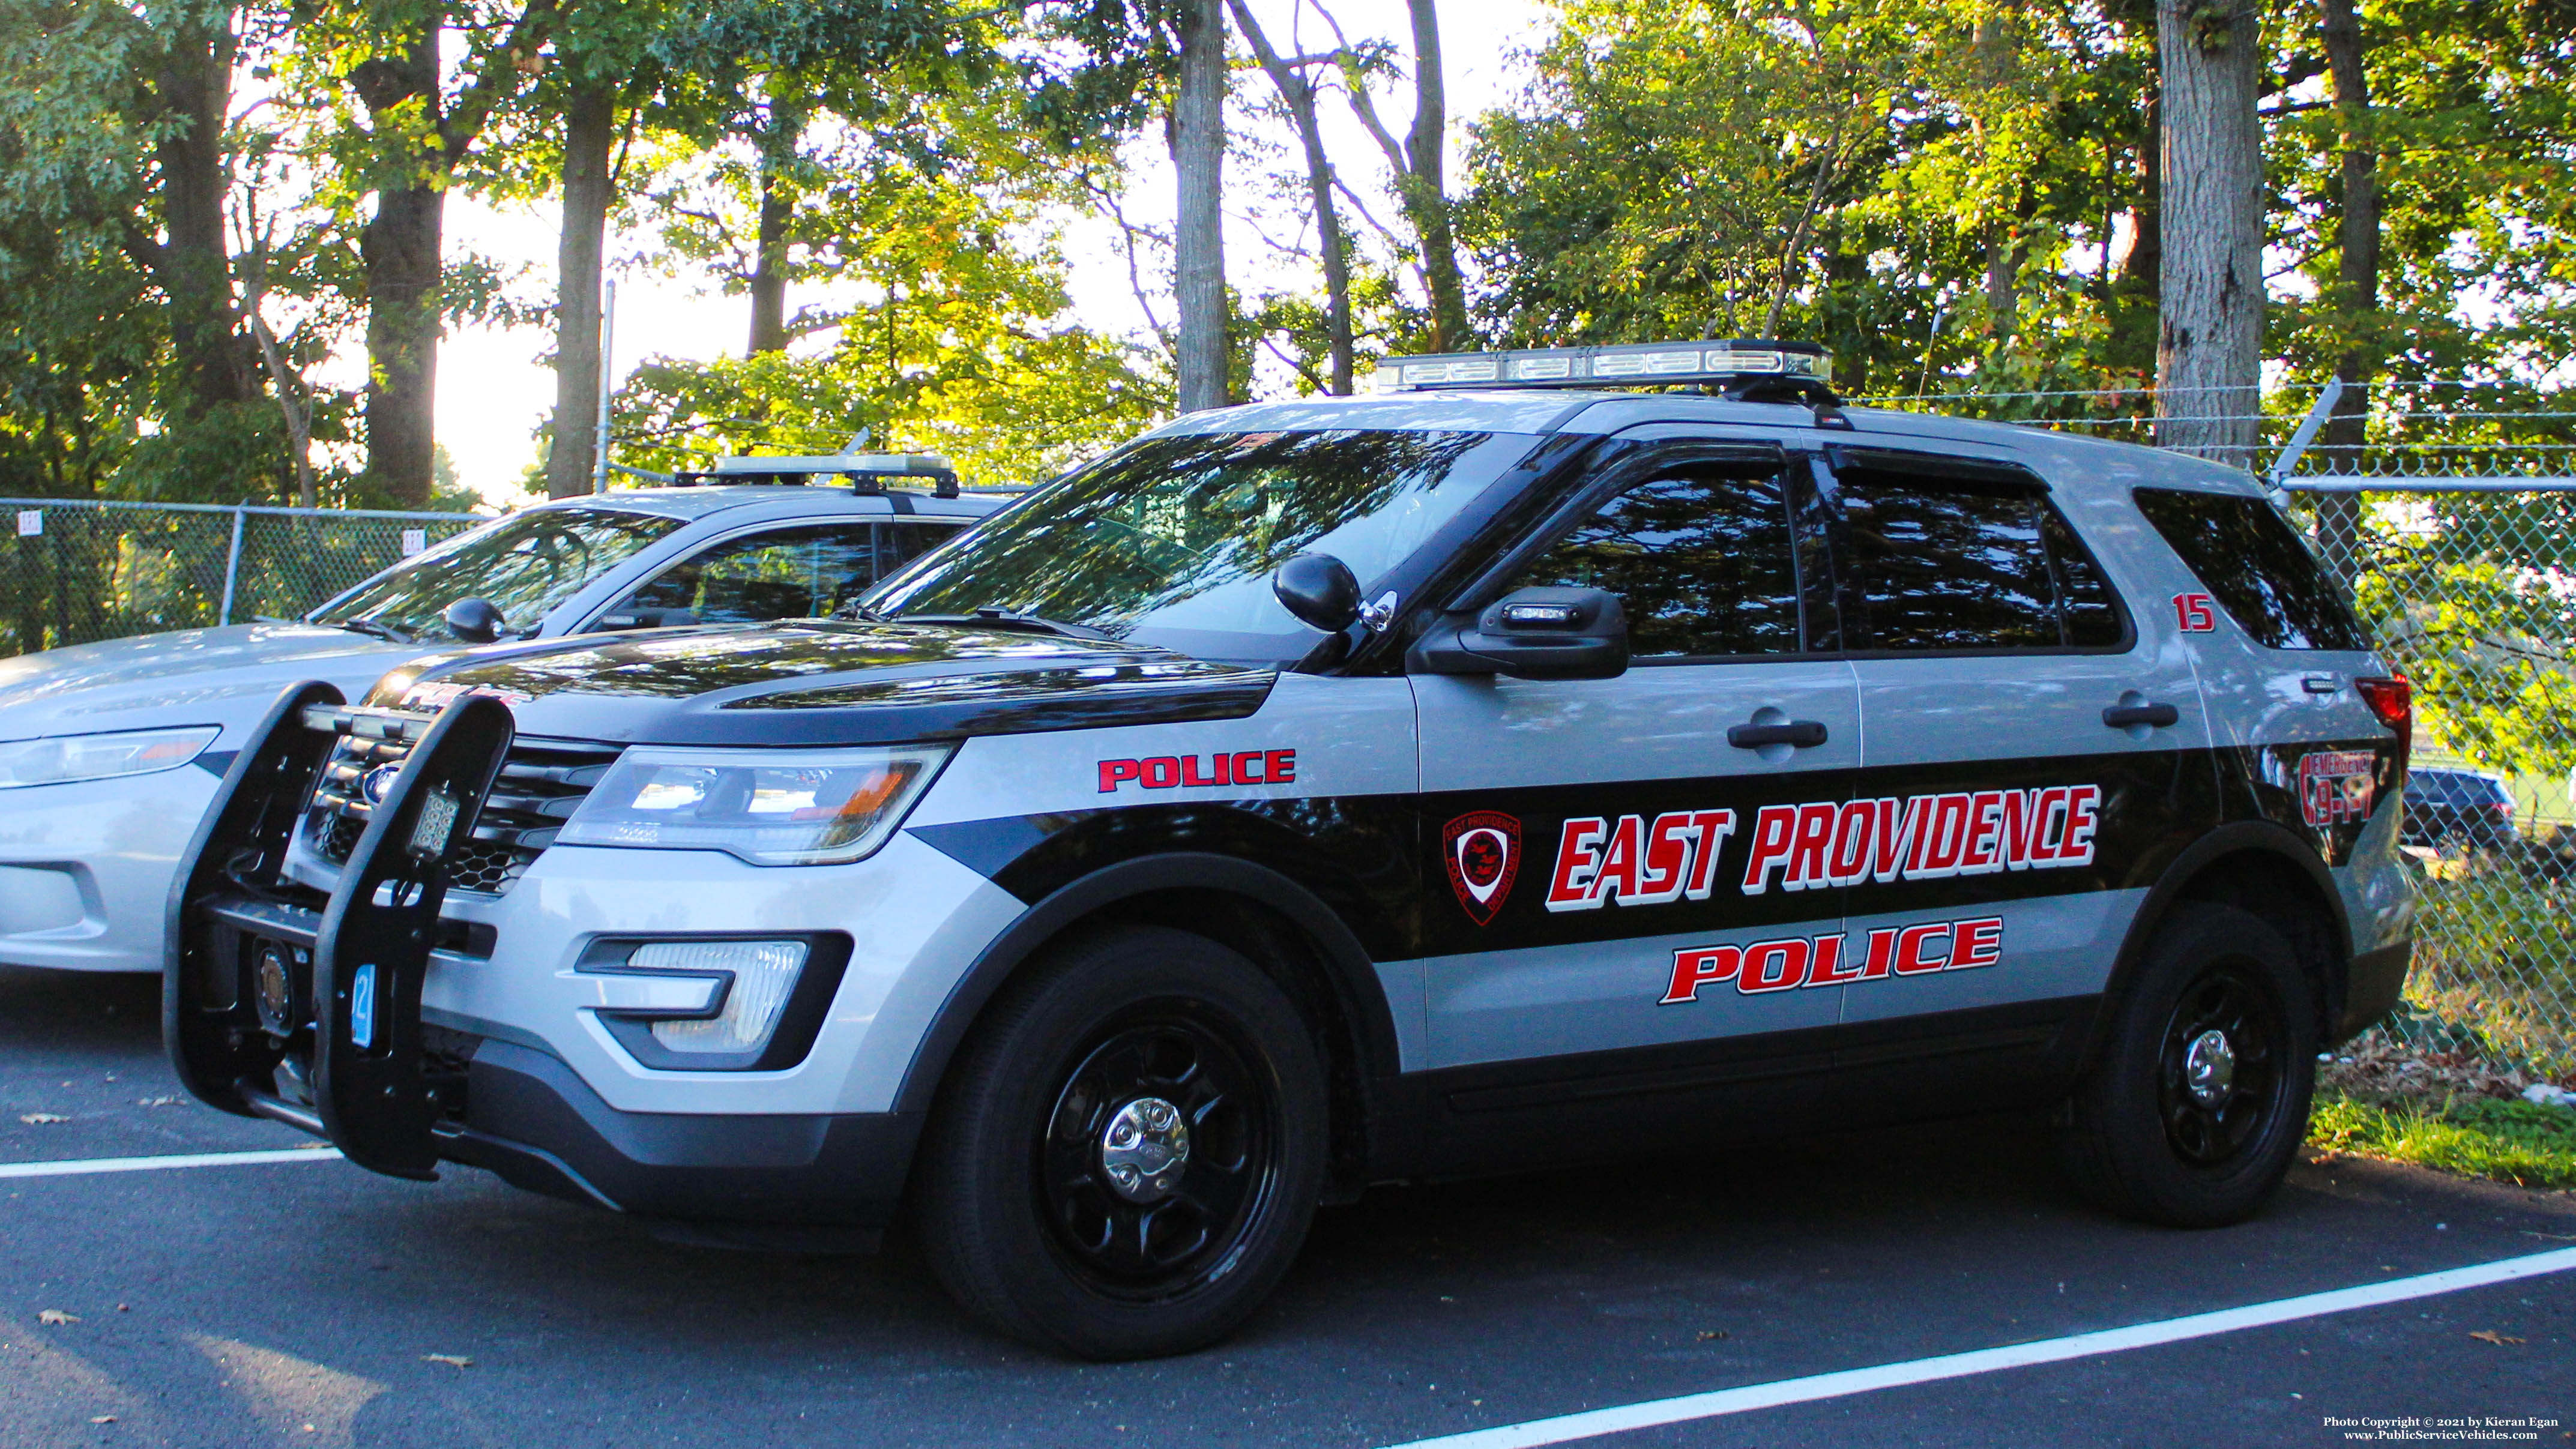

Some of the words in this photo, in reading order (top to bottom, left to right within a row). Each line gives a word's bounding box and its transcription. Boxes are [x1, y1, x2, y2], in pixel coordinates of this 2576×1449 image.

[2171, 592, 2215, 633] 15
[1098, 749, 1296, 794] POLICE
[1446, 821, 1465, 840] EAST
[1468, 816, 1518, 835] PROVIDENCE
[1546, 809, 1736, 912] EAST
[1742, 784, 2102, 896] PROVIDENCE
[1447, 857, 1470, 902] POLICE
[1488, 840, 1518, 911] DEPARTMENT
[1656, 917, 2003, 1006] POLICE
